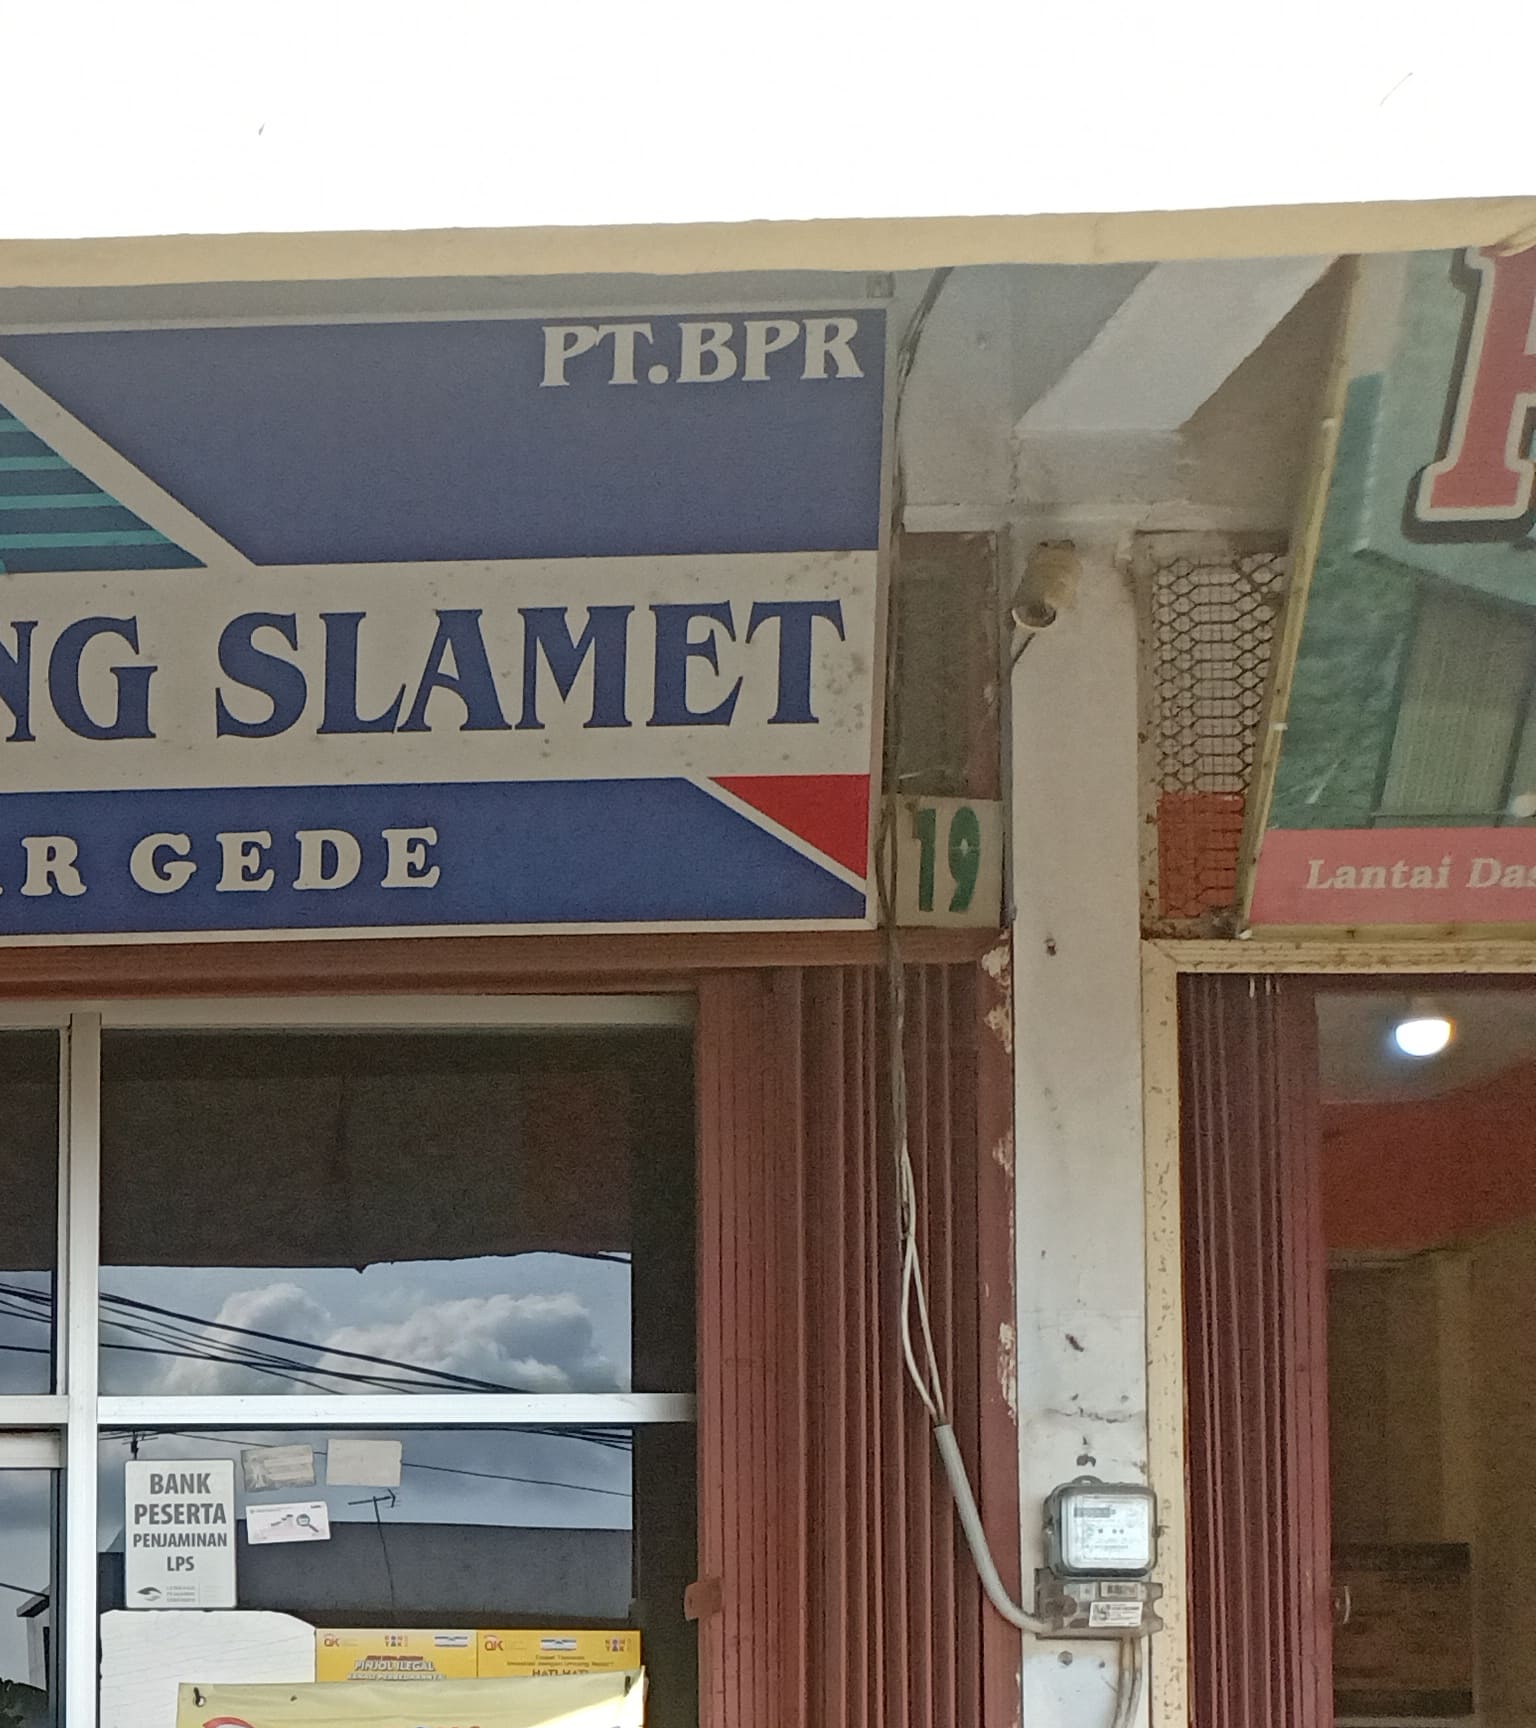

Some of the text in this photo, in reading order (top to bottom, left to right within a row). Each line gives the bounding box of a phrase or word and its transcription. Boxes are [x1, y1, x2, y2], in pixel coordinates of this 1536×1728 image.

[540, 318, 864, 387] PT.BPR
[215, 598, 847, 740] SLAMET
[129, 825, 442, 895] GEDE
[913, 806, 981, 913] 19
[1305, 858, 1450, 890] Lantai
[150, 1473, 211, 1494] BANK
[134, 1503, 227, 1525] PESERTA
[133, 1533, 227, 1548] PENJAMINAN
[167, 1556, 194, 1571] LPS
